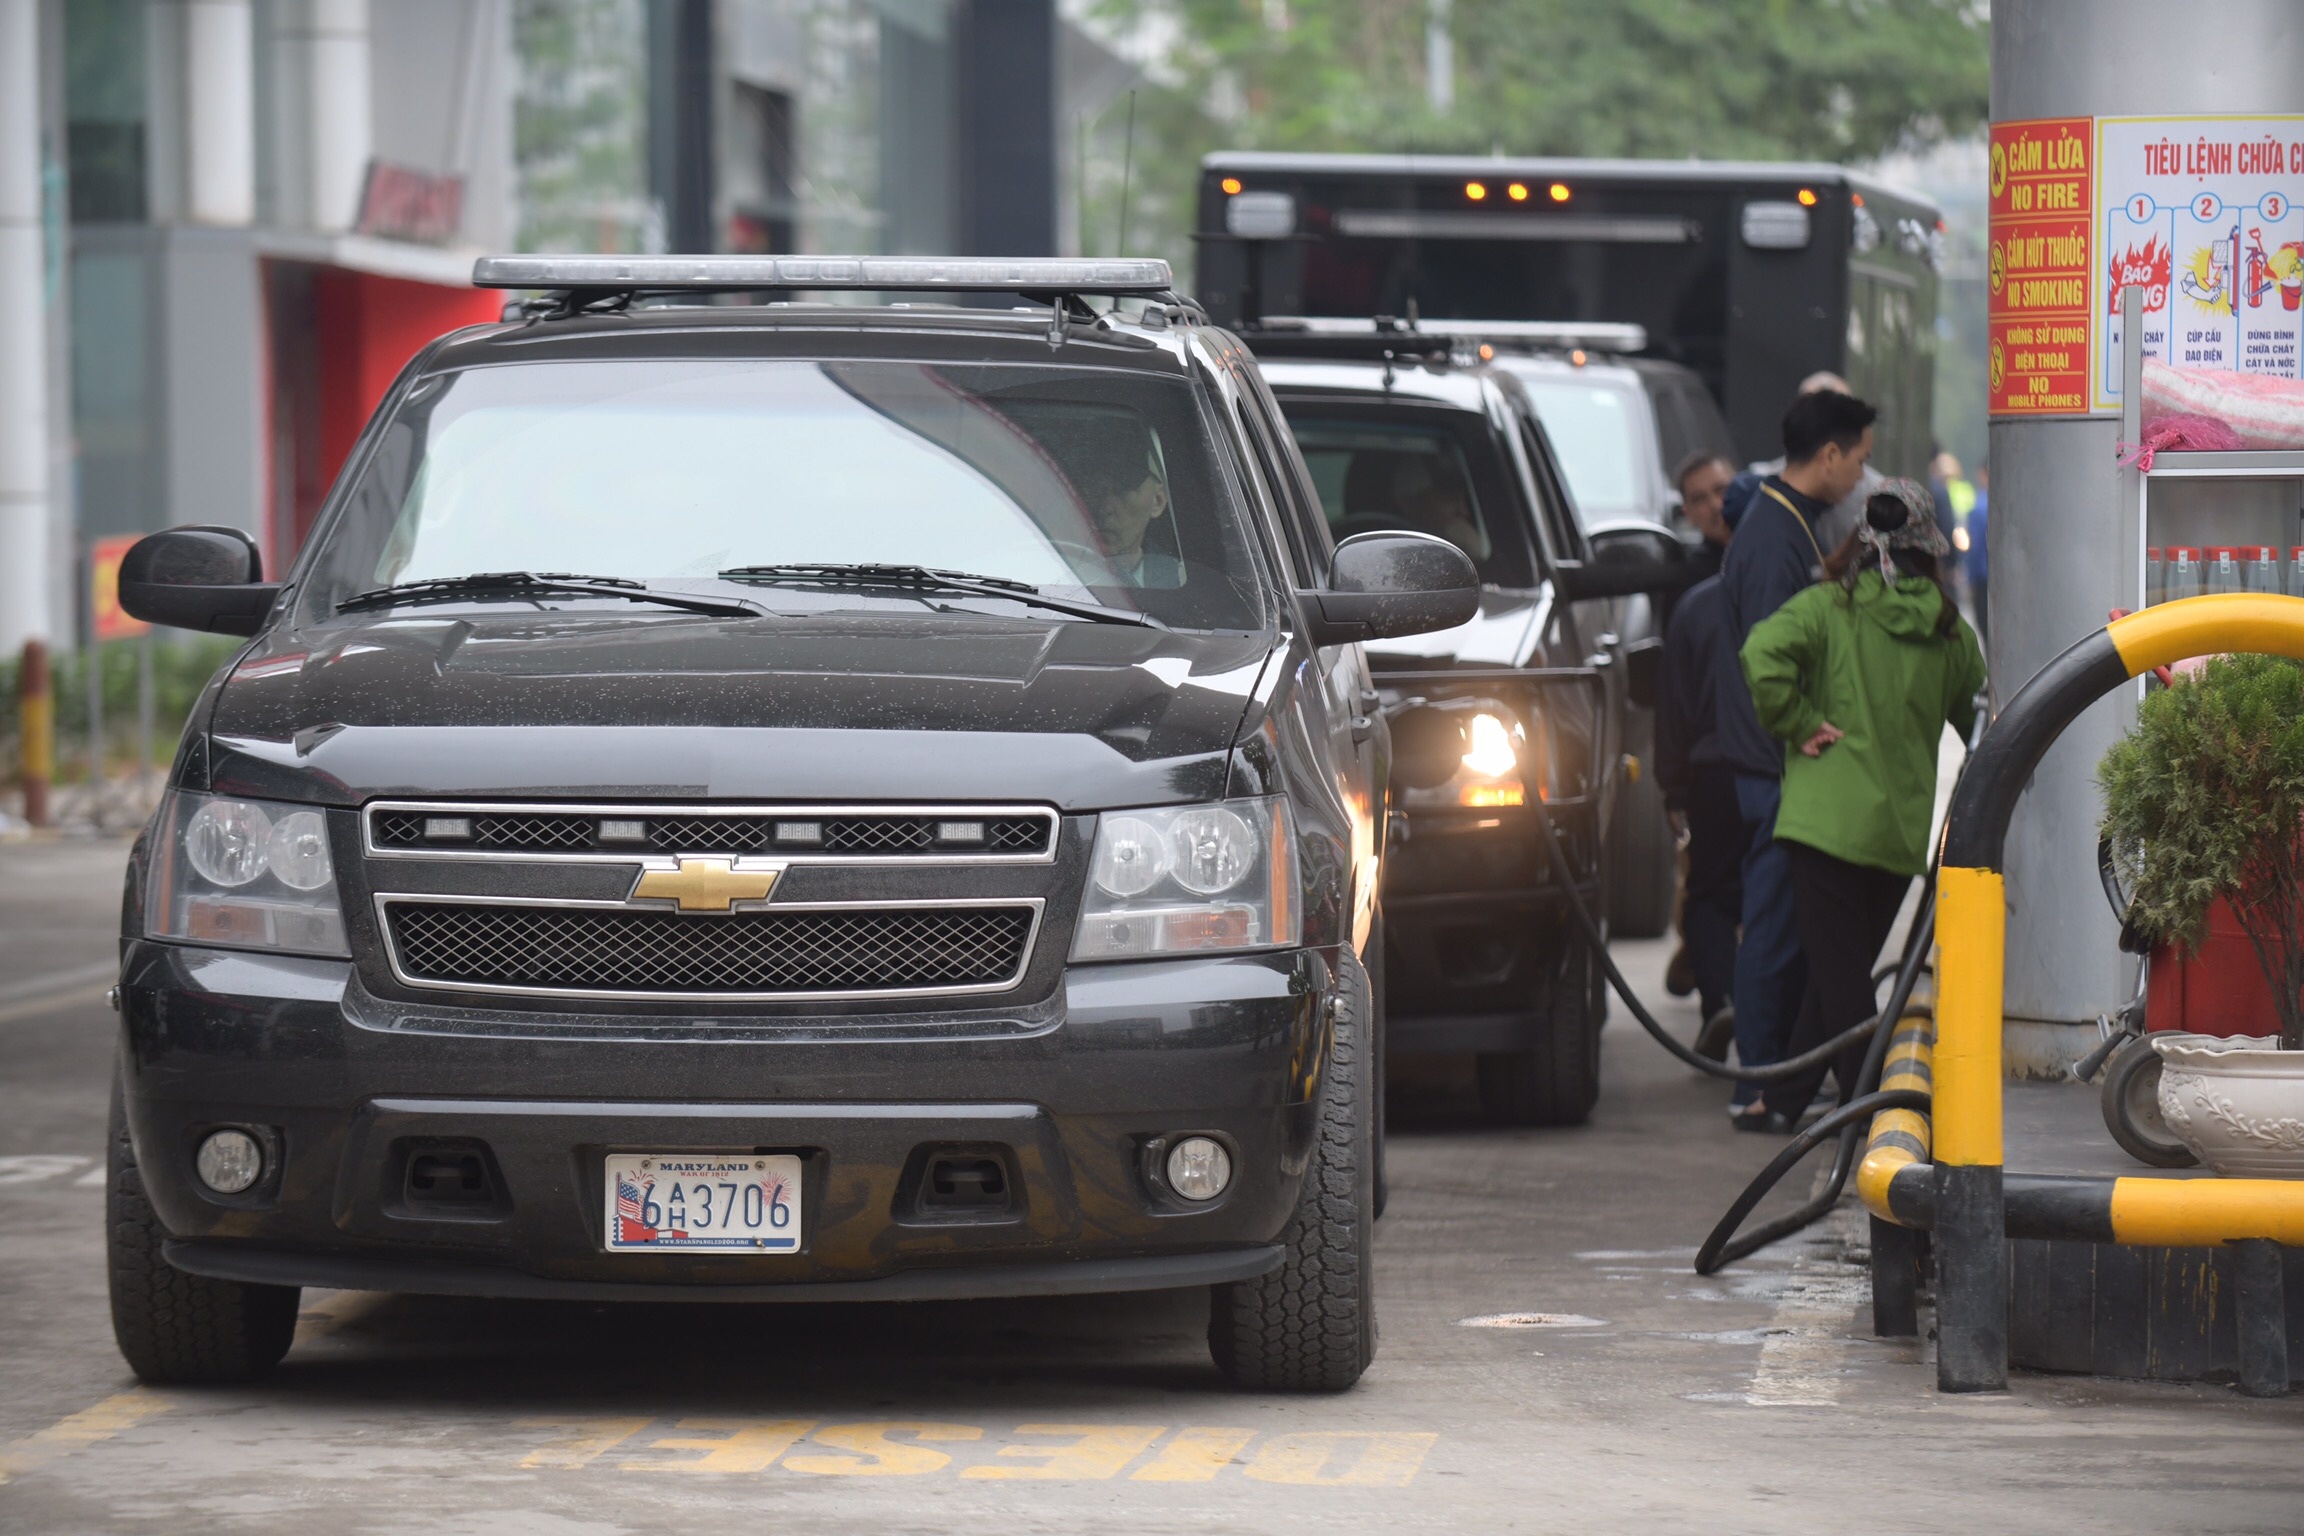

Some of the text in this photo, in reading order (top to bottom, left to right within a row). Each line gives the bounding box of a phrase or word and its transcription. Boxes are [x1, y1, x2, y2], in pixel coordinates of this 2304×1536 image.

[2047, 126, 2085, 170] LỬA
[2144, 136, 2181, 175] TIÊU
[2187, 136, 2232, 182] LỆNH
[2238, 134, 2284, 175] CHỮA
[2011, 182, 2080, 211] NO FIRE
[2135, 199, 2144, 218] 1
[2201, 197, 2213, 217] 2
[2268, 197, 2279, 217] 3
[2026, 231, 2045, 268] HÚT
[2047, 225, 2085, 267] THUỐC
[2121, 261, 2153, 285] BÁO
[2007, 279, 2083, 308] NO SMOKING
[2052, 326, 2085, 347] DỤNG
[2037, 352, 2069, 372] THOẠI
[2029, 376, 2049, 394] NO
[2008, 393, 2081, 408] MOBILE PHONES
[660, 1163, 749, 1171] MARYLAND
